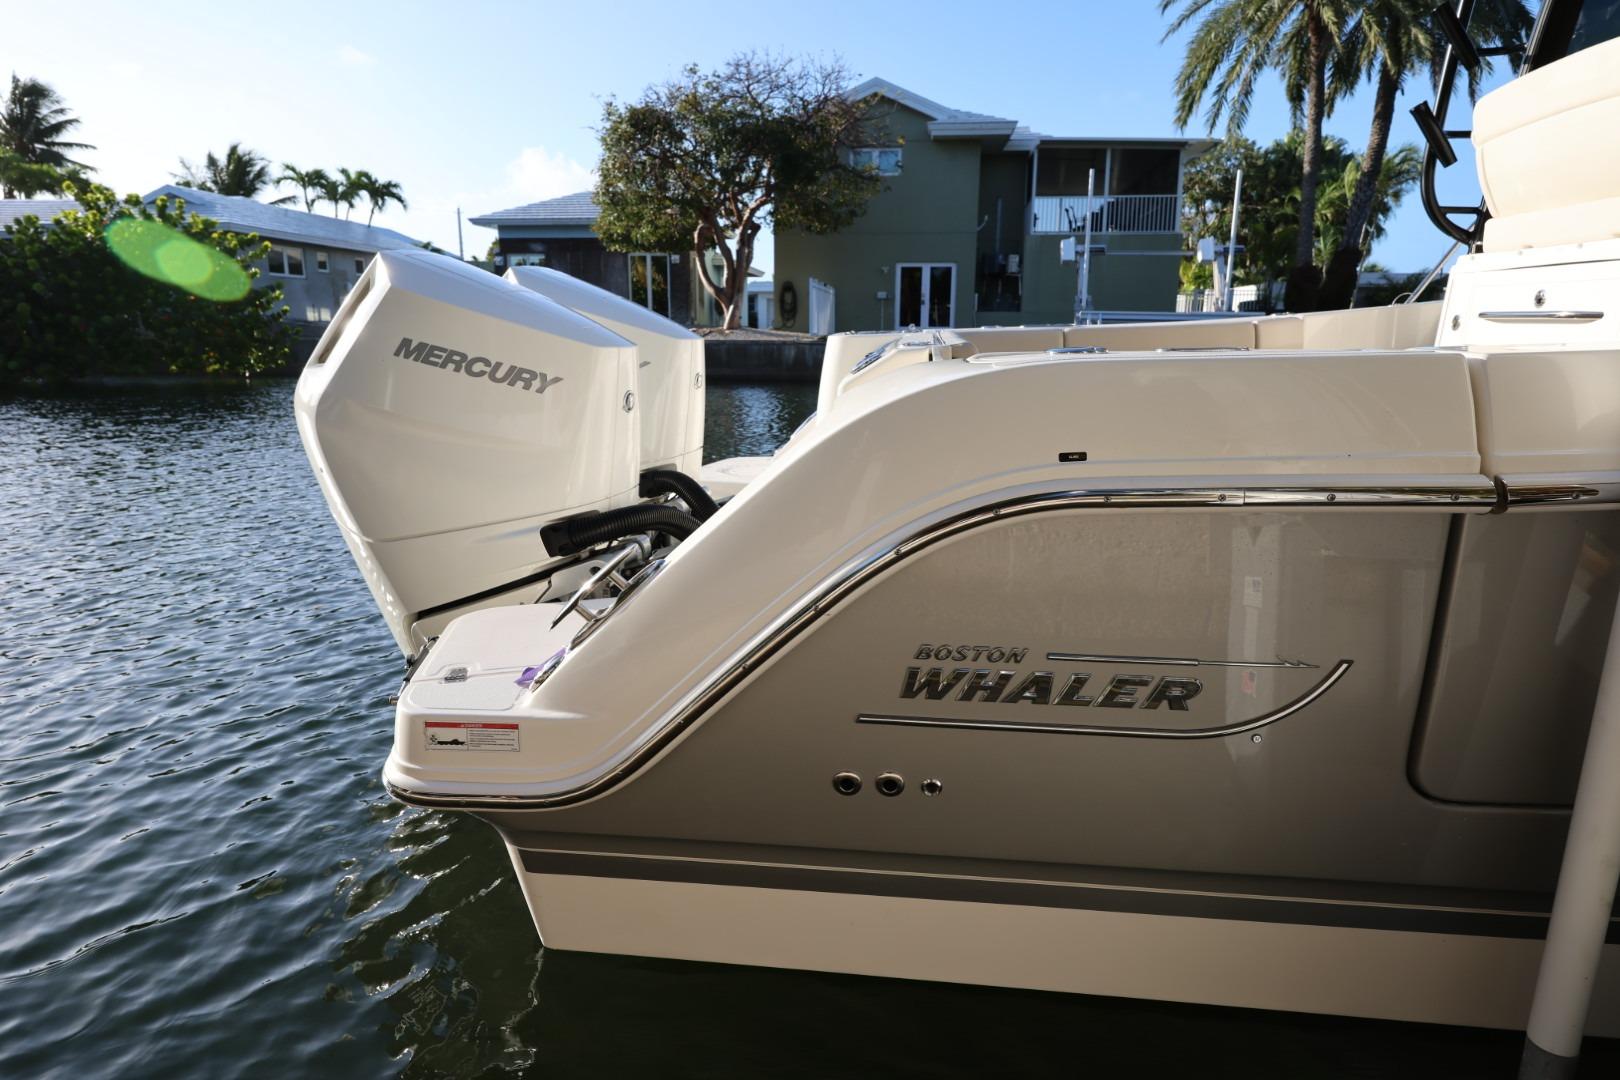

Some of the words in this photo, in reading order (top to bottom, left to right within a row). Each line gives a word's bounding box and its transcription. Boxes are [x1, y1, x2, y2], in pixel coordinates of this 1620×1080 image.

[393, 337, 563, 394] MERCURY
[913, 643, 1029, 664] BOSTON
[899, 666, 1203, 711] WHALER
